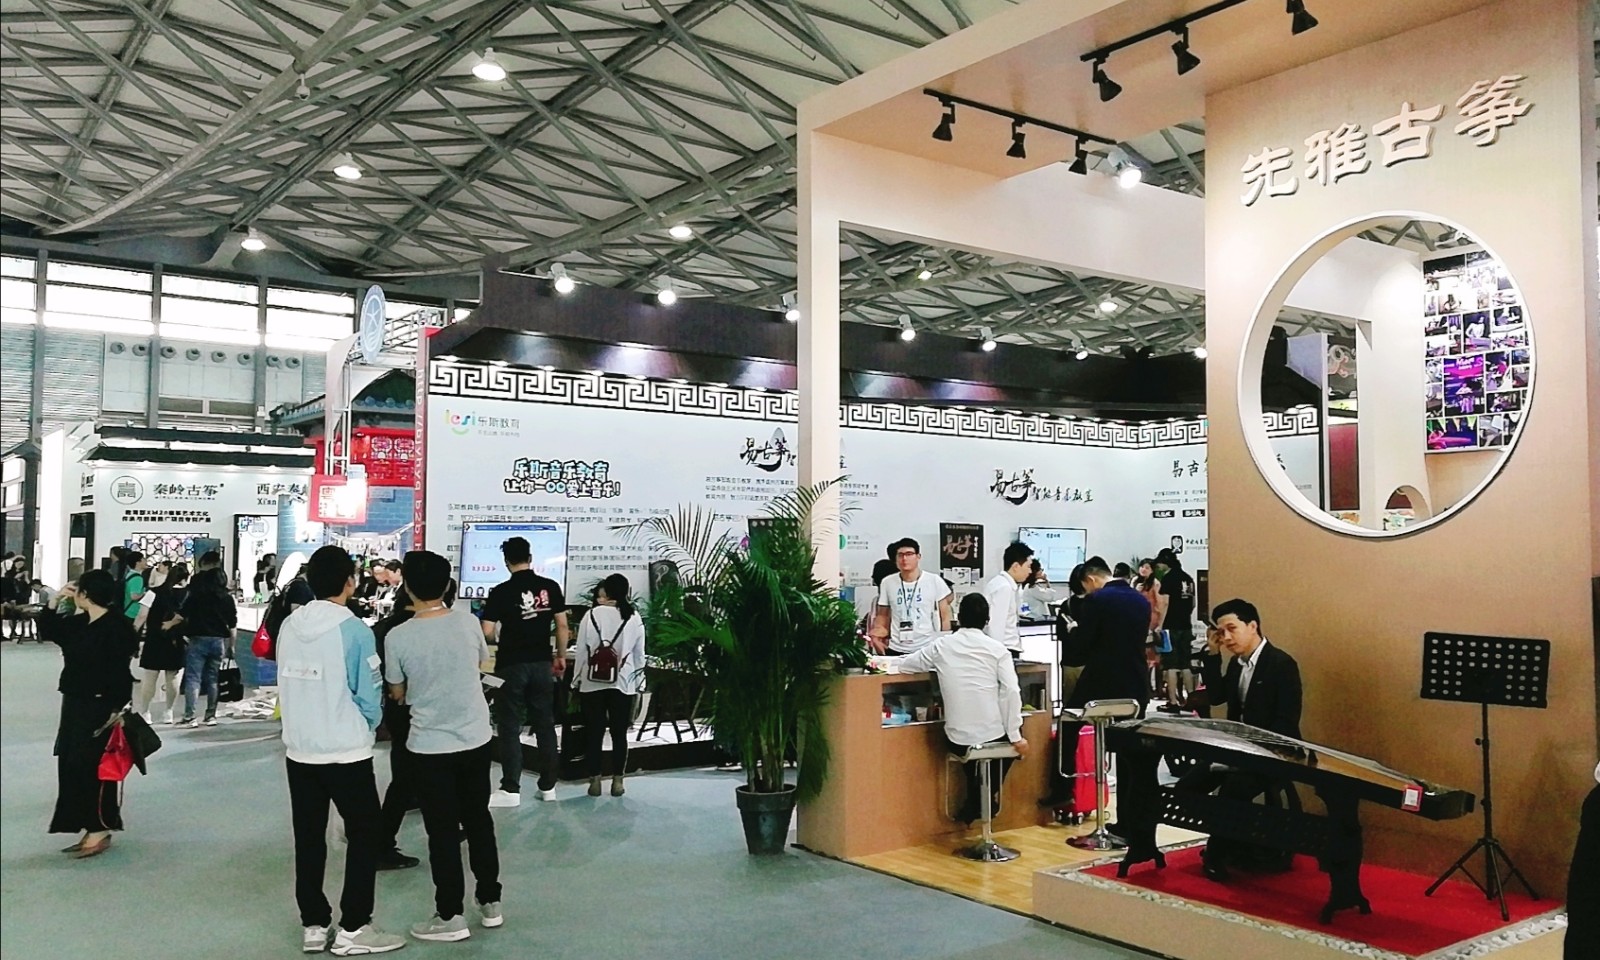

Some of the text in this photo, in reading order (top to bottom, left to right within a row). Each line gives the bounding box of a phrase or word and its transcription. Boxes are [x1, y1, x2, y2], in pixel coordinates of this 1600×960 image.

[1240, 74, 1536, 207] 先雅古筝
[478, 415, 521, 430] 乐斯教育
[512, 457, 610, 482] 乐斯音乐教育
[1172, 459, 1208, 478] 易古
[153, 483, 219, 497] 秦岭古筝
